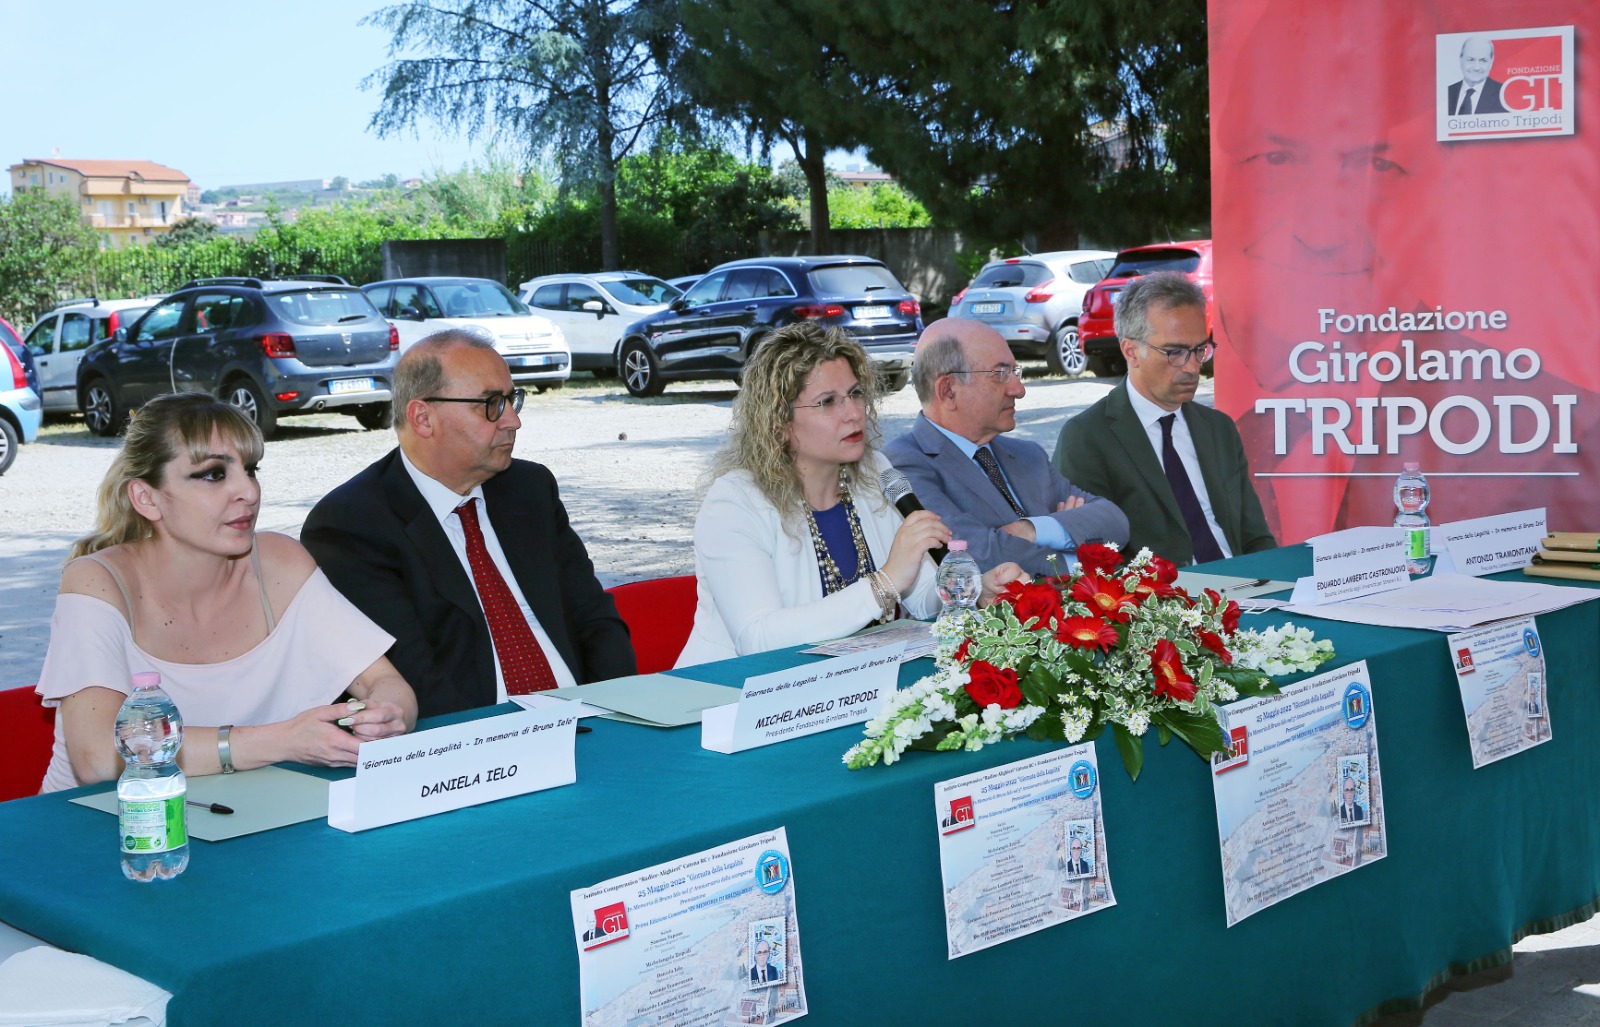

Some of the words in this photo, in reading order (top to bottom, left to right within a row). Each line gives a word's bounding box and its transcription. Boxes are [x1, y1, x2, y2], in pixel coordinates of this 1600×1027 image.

[1507, 65, 1560, 75] FONDAZIONE
[1500, 74, 1563, 112] GT
[1448, 118, 1510, 130] Girolamo
[1513, 114, 1562, 127] Tripodi
[1318, 305, 1507, 333] Fondazione
[1288, 340, 1541, 383] Girolamo
[1255, 394, 1578, 455] TRIPODI
[1466, 553, 1494, 565] ANTONIO
[1495, 546, 1538, 560] TRAMONTANA
[1317, 578, 1341, 590] EDUARDO
[1342, 573, 1368, 585] LAMBERTI
[1369, 565, 1406, 579] CASTRONUOVO
[776, 683, 791, 691] della
[792, 675, 818, 688] Legalità
[834, 666, 859, 677] memoria
[869, 660, 885, 668] Bruno
[755, 700, 834, 729] MICHELANGELO
[839, 689, 879, 708] TRIPODI
[766, 727, 794, 738] Presidente
[796, 720, 825, 732] Fondazione
[826, 712, 849, 724] Girolamo
[850, 707, 868, 719] Tripodi
[406, 750, 426, 761] della
[429, 742, 462, 757] Legalità
[474, 737, 484, 746] In
[486, 730, 519, 743] memoria
[522, 727, 530, 735] di
[532, 723, 554, 733] Bruno
[557, 716, 576, 728] Ielo"
[421, 774, 481, 798] DANIELA
[486, 765, 518, 783] IELO
[988, 782, 1005, 792] Maggio
[604, 879, 638, 893] Comprensivo
[712, 849, 738, 860] Fondazione
[760, 836, 777, 846] Tripodi
[638, 890, 646, 898] 25
[647, 882, 670, 895] Maggio
[670, 878, 686, 887] 2022
[712, 863, 724, 874] della
[603, 914, 624, 935] GT
